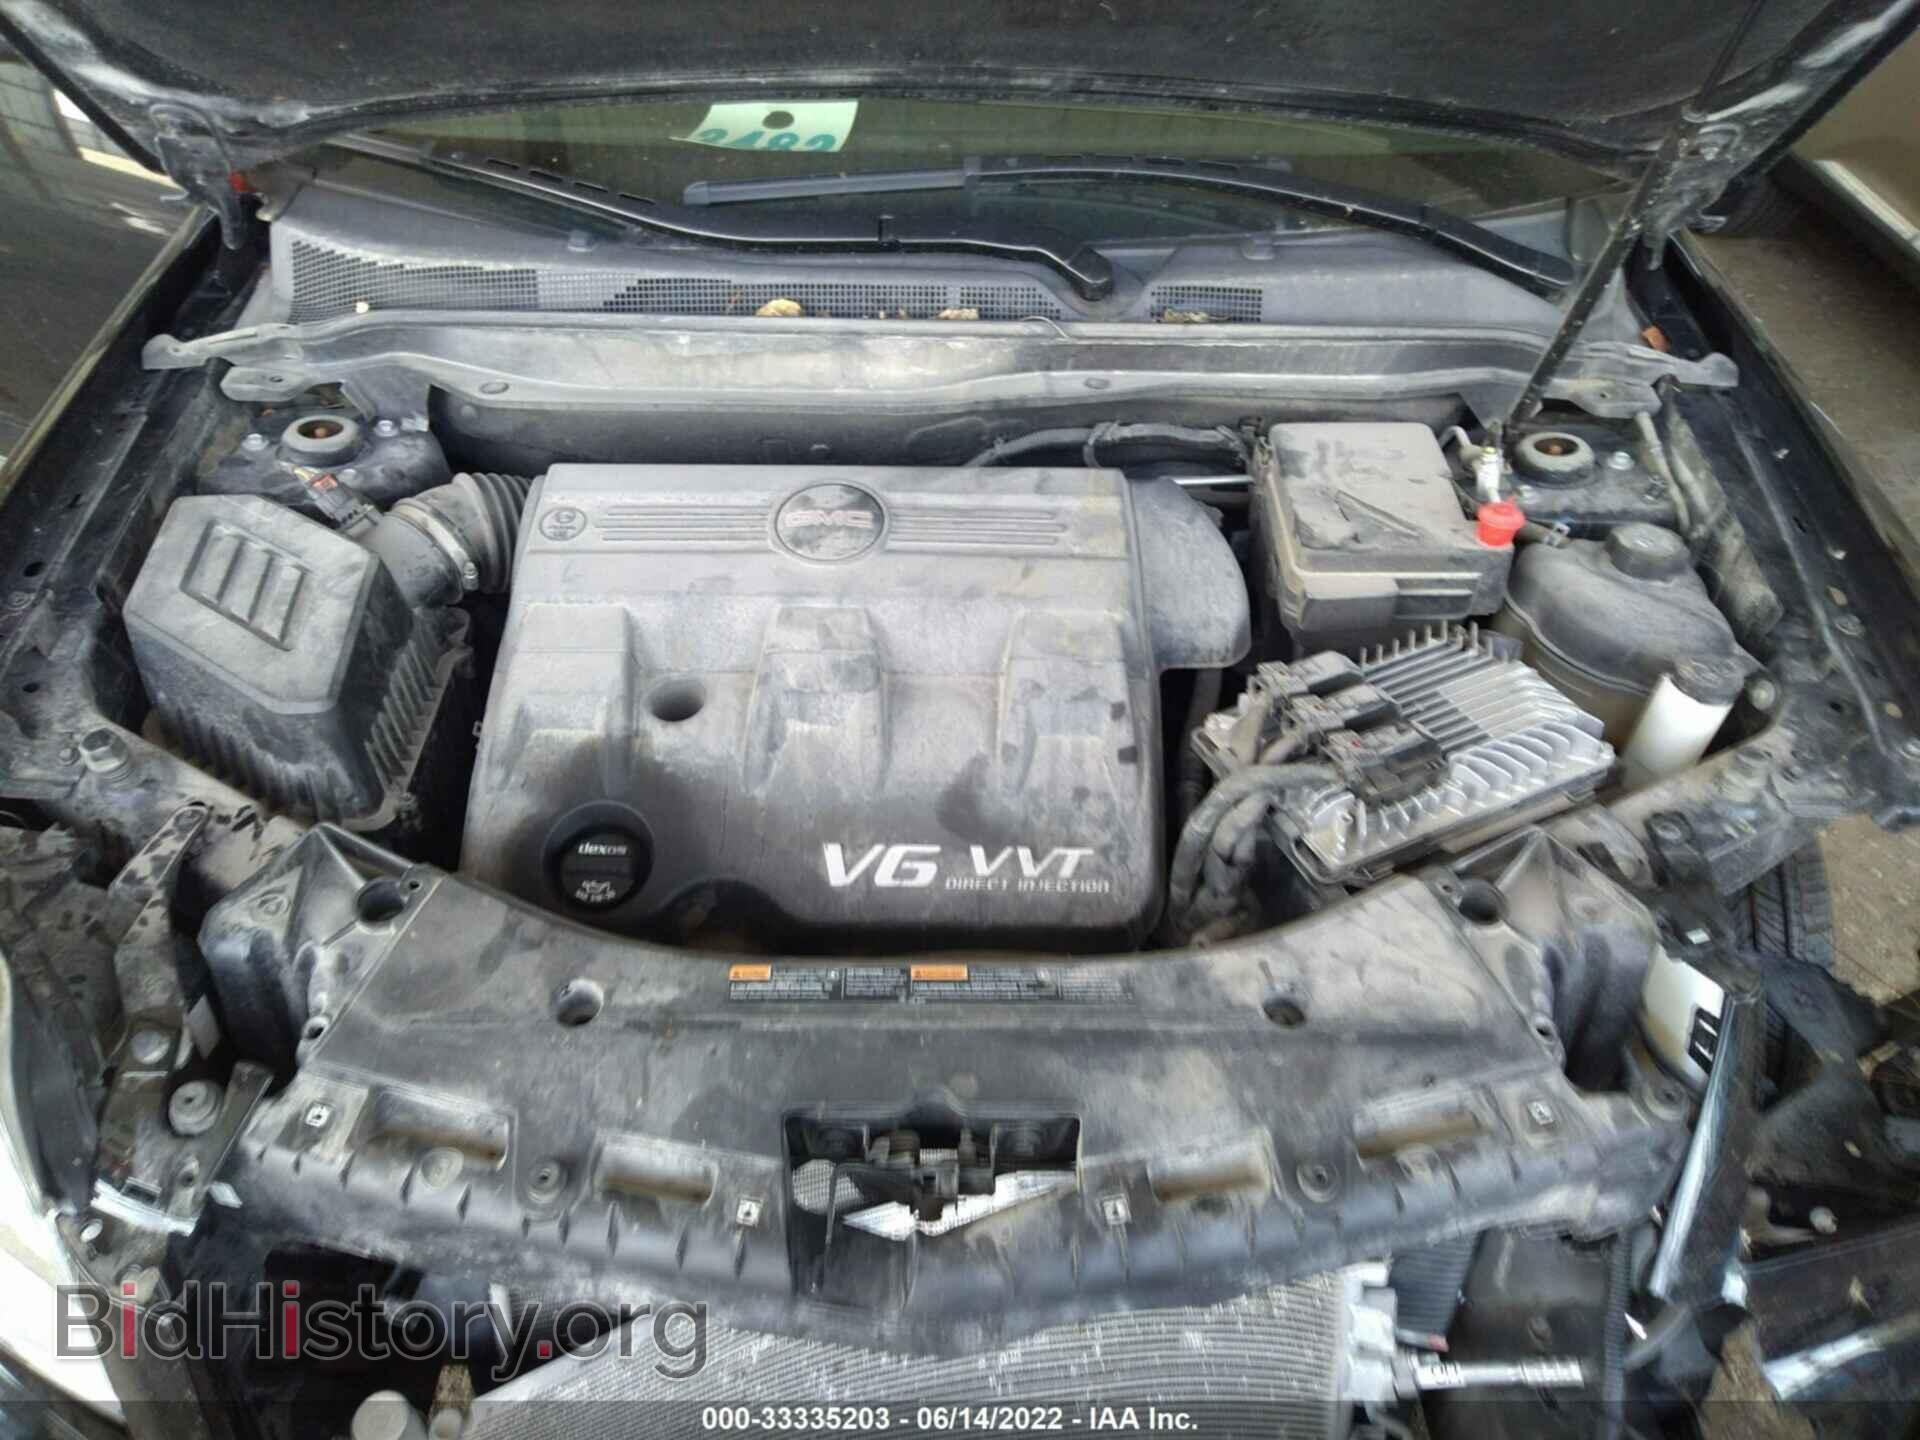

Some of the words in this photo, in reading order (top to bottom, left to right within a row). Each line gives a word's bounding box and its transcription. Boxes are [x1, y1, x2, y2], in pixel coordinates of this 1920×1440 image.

[784, 509, 874, 529] GMC
[823, 842, 941, 888] V6
[970, 844, 1095, 879] VVT
[945, 876, 1009, 892] DIRECT
[1017, 877, 1110, 894] INJECTION
